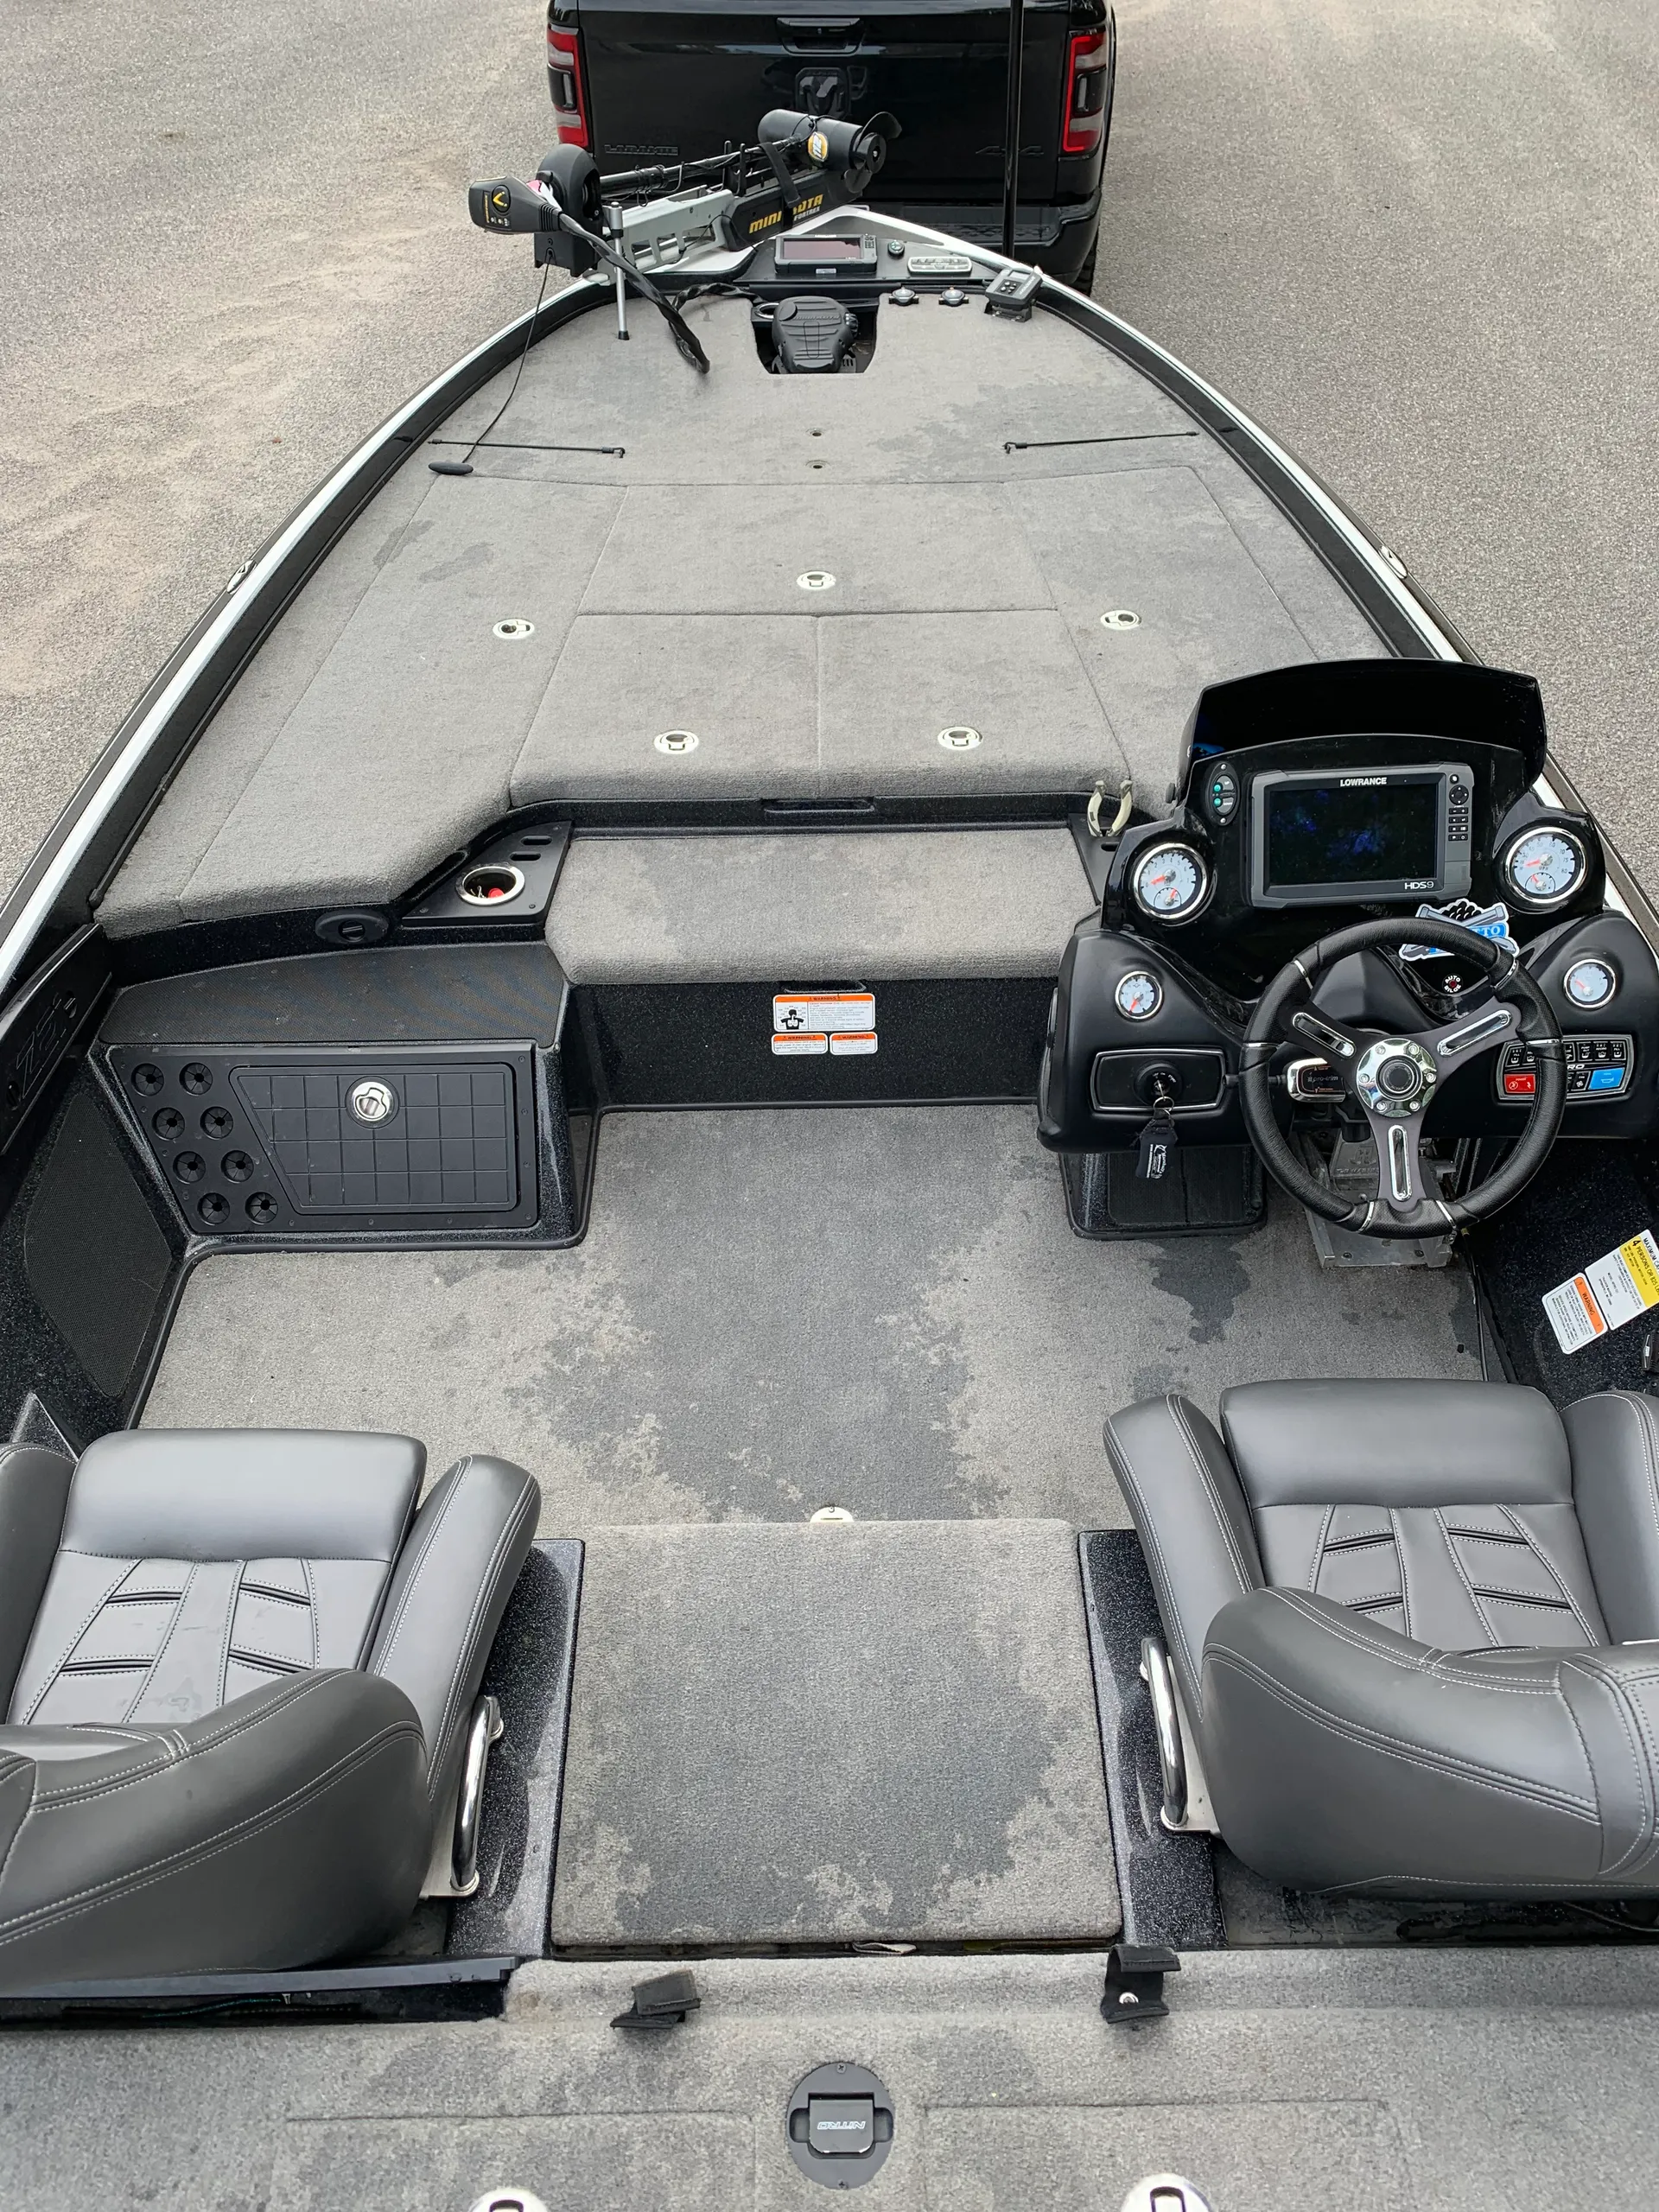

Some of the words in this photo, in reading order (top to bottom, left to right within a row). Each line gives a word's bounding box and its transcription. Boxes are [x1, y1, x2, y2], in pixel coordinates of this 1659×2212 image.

[793, 194, 823, 215] OTA
[1339, 777, 1388, 787] LOWRANCE
[1444, 975, 1461, 984] AUTO
[1443, 984, 1462, 993] BILGE
[1635, 1246, 1650, 1269] PERSONS
[1645, 1268, 1654, 1277] OR
[1581, 1291, 1595, 1315] WARNING
[817, 2121, 866, 2130] NITRO
